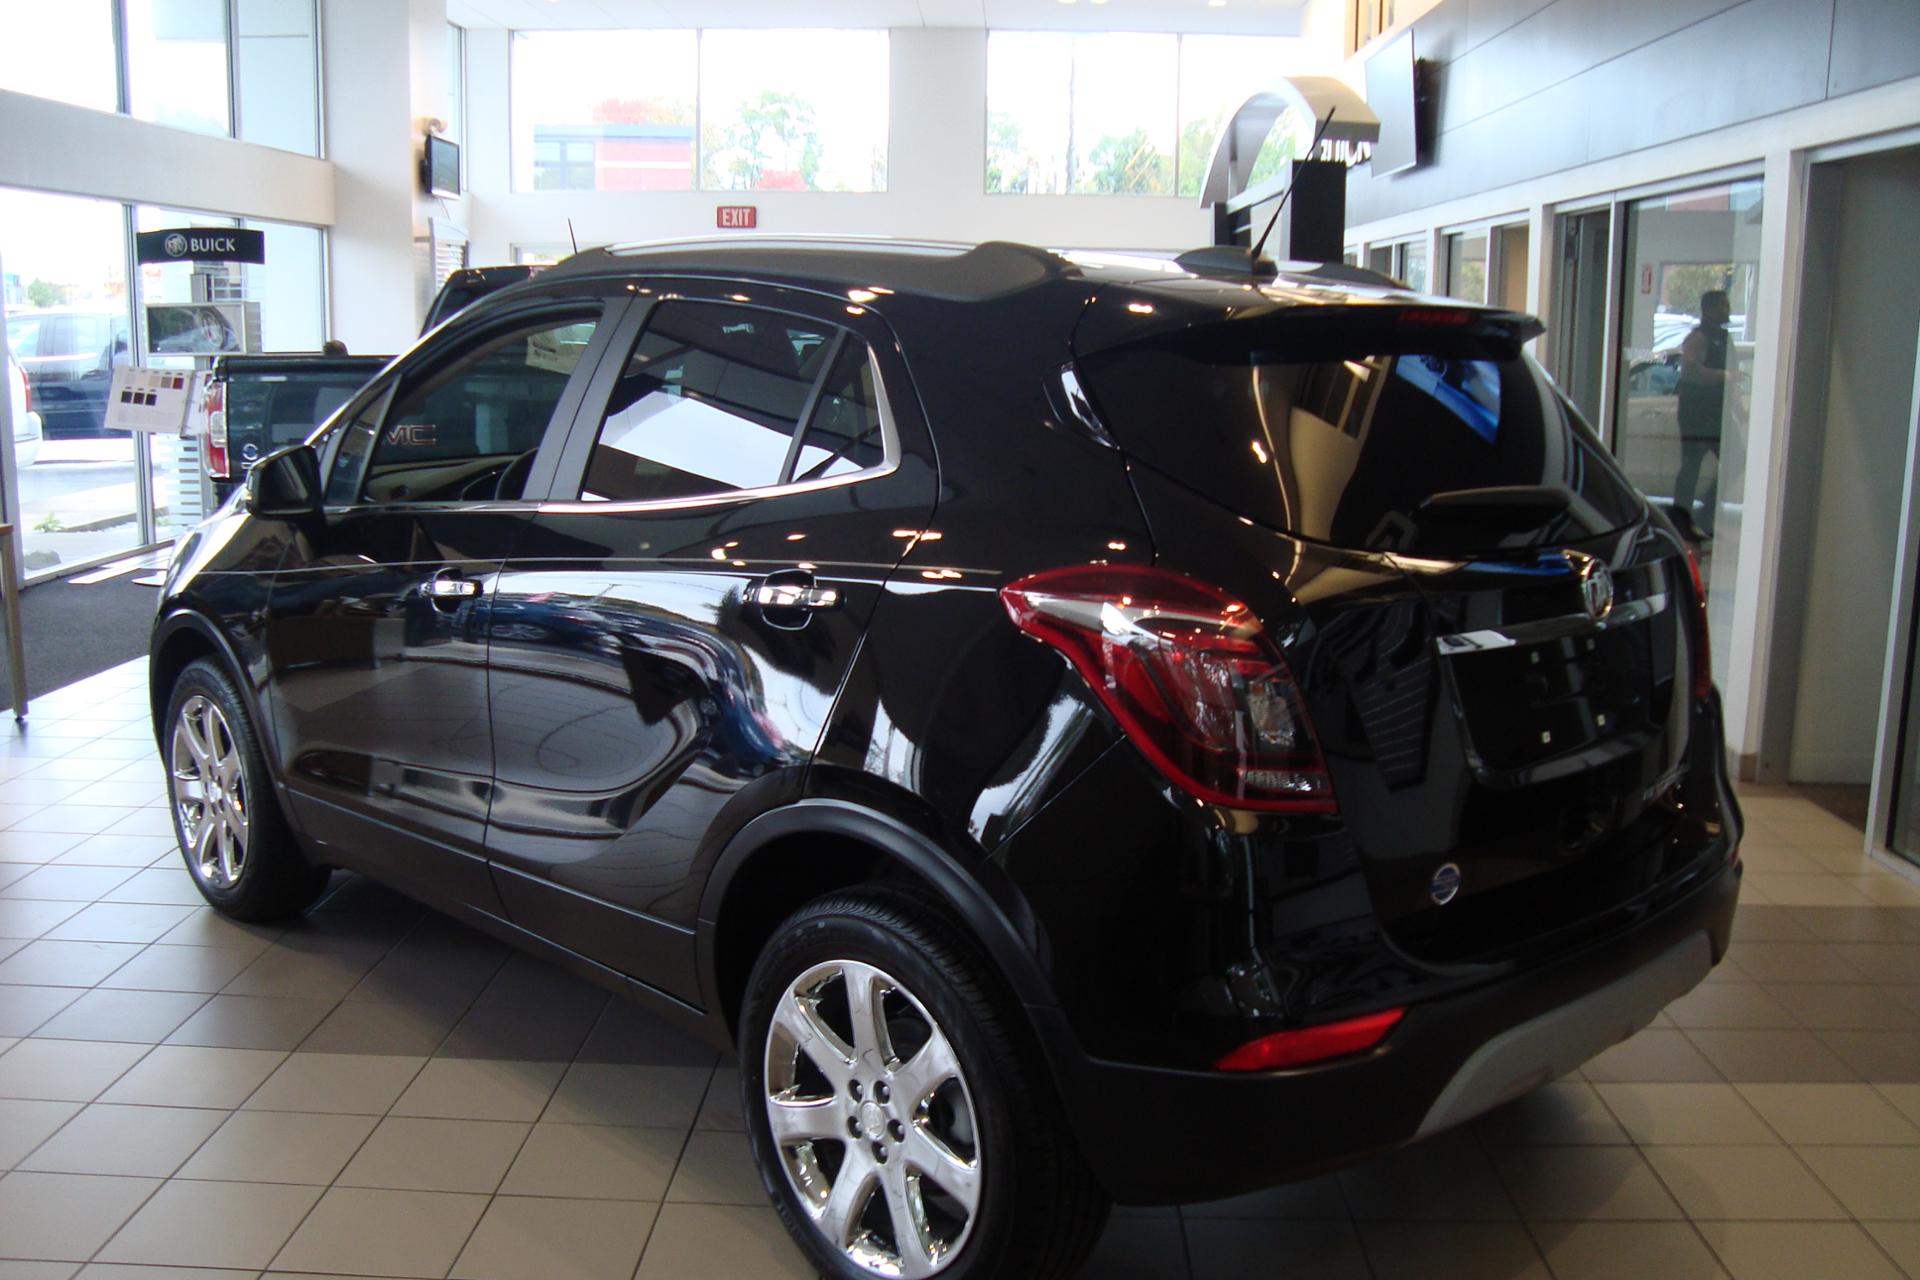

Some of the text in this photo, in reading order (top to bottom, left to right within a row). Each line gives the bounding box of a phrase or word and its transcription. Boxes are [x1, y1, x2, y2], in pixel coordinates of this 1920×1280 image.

[722, 208, 751, 227] EXIT
[190, 238, 236, 252] BUICK
[385, 424, 437, 446] MC
